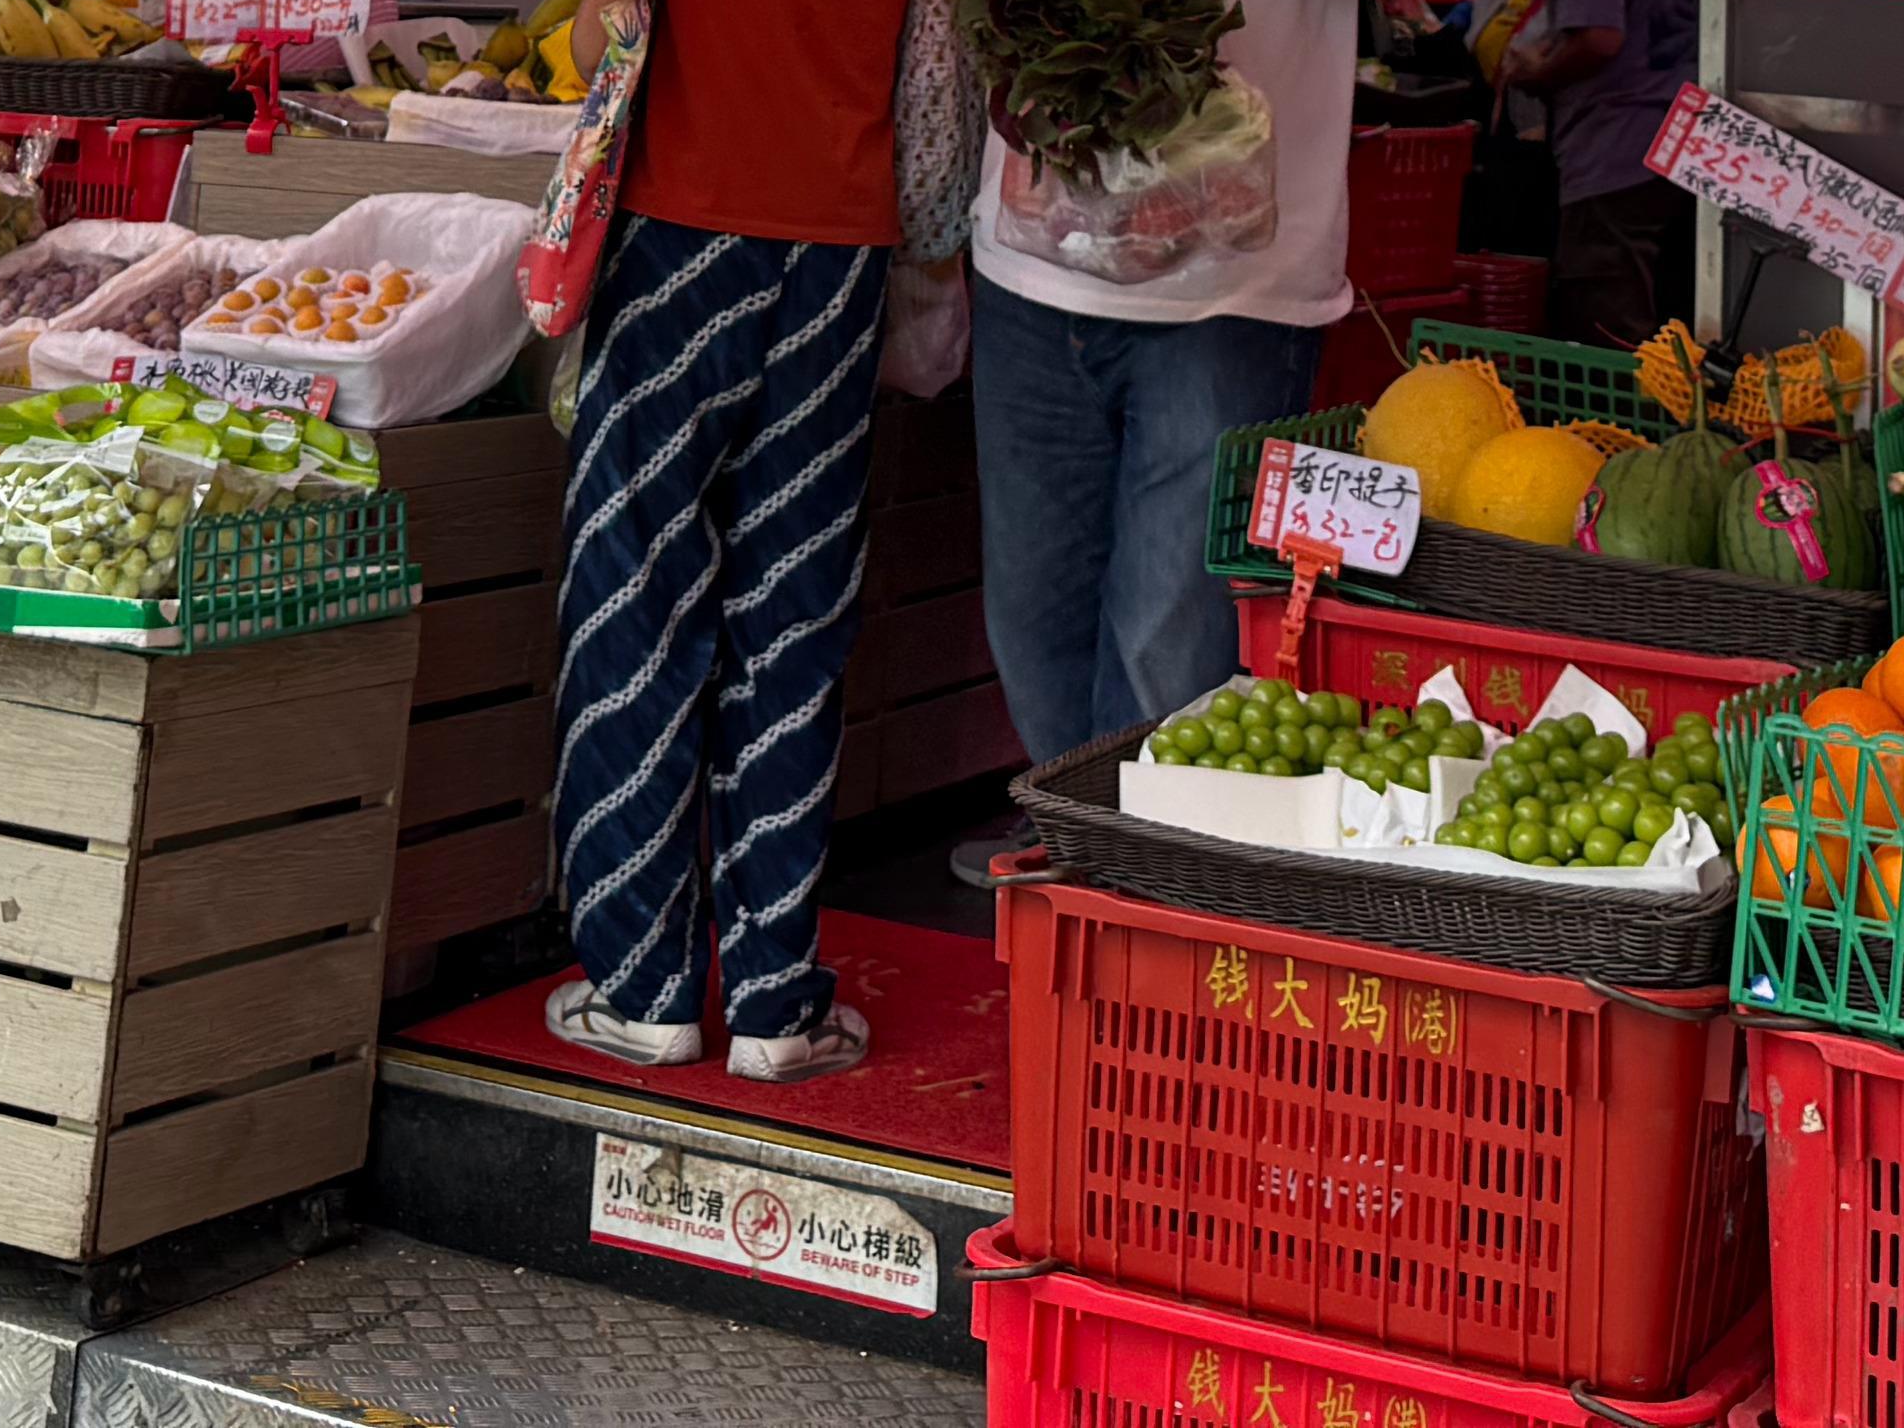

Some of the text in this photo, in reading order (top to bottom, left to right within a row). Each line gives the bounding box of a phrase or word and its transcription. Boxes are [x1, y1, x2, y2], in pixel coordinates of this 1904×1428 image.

[1288, 451, 1420, 509] 香印提子
[602, 1202, 654, 1226] CAUTION
[683, 1220, 726, 1242] FLOOR
[606, 1168, 924, 1270] 小心地滑 小心梯級
[800, 1248, 921, 1288] BEWARE OF STEP
